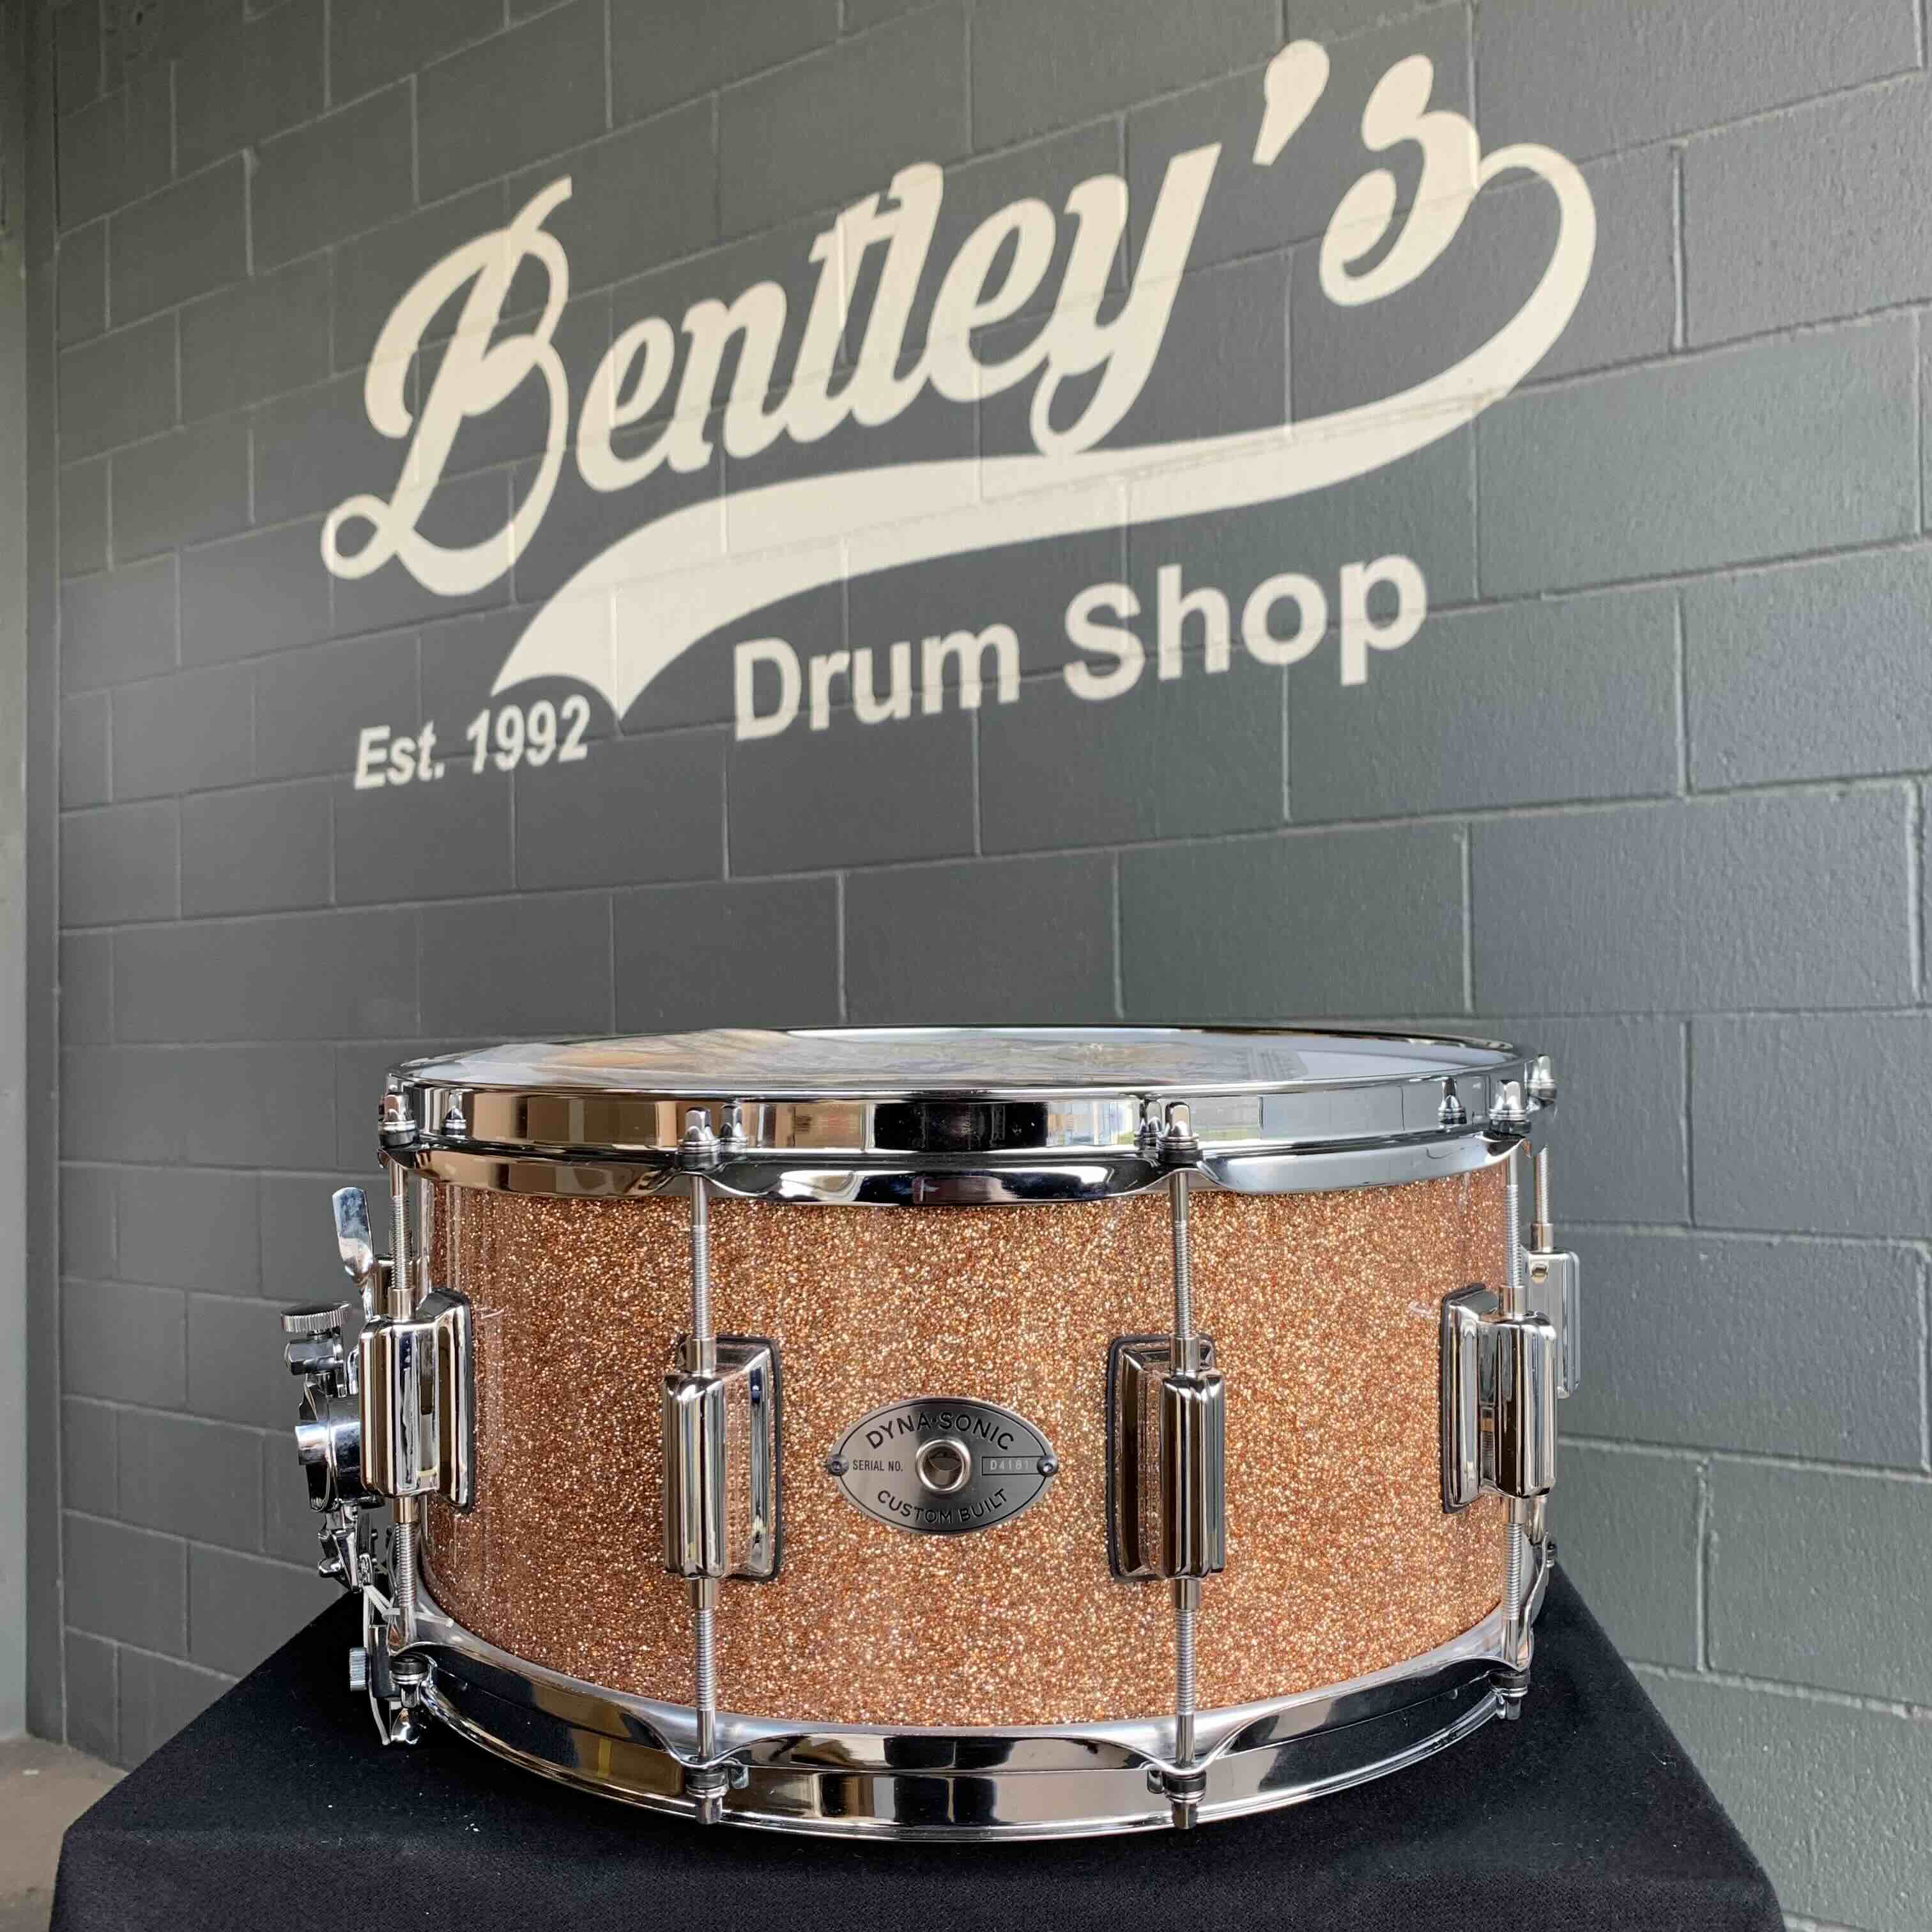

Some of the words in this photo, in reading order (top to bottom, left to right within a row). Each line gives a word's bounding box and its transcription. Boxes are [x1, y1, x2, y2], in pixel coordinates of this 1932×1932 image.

[321, 40, 1482, 597] Bentley's
[734, 624, 1021, 741] Drum
[1064, 554, 1428, 702] Shop
[353, 720, 445, 790] Est.
[466, 694, 591, 774] 1992
[853, 1459, 885, 1471] SERIAL
[888, 1460, 904, 1472] NO.
[878, 1489, 953, 1524] CUSTOM
[959, 1488, 1008, 1522] BUILT
